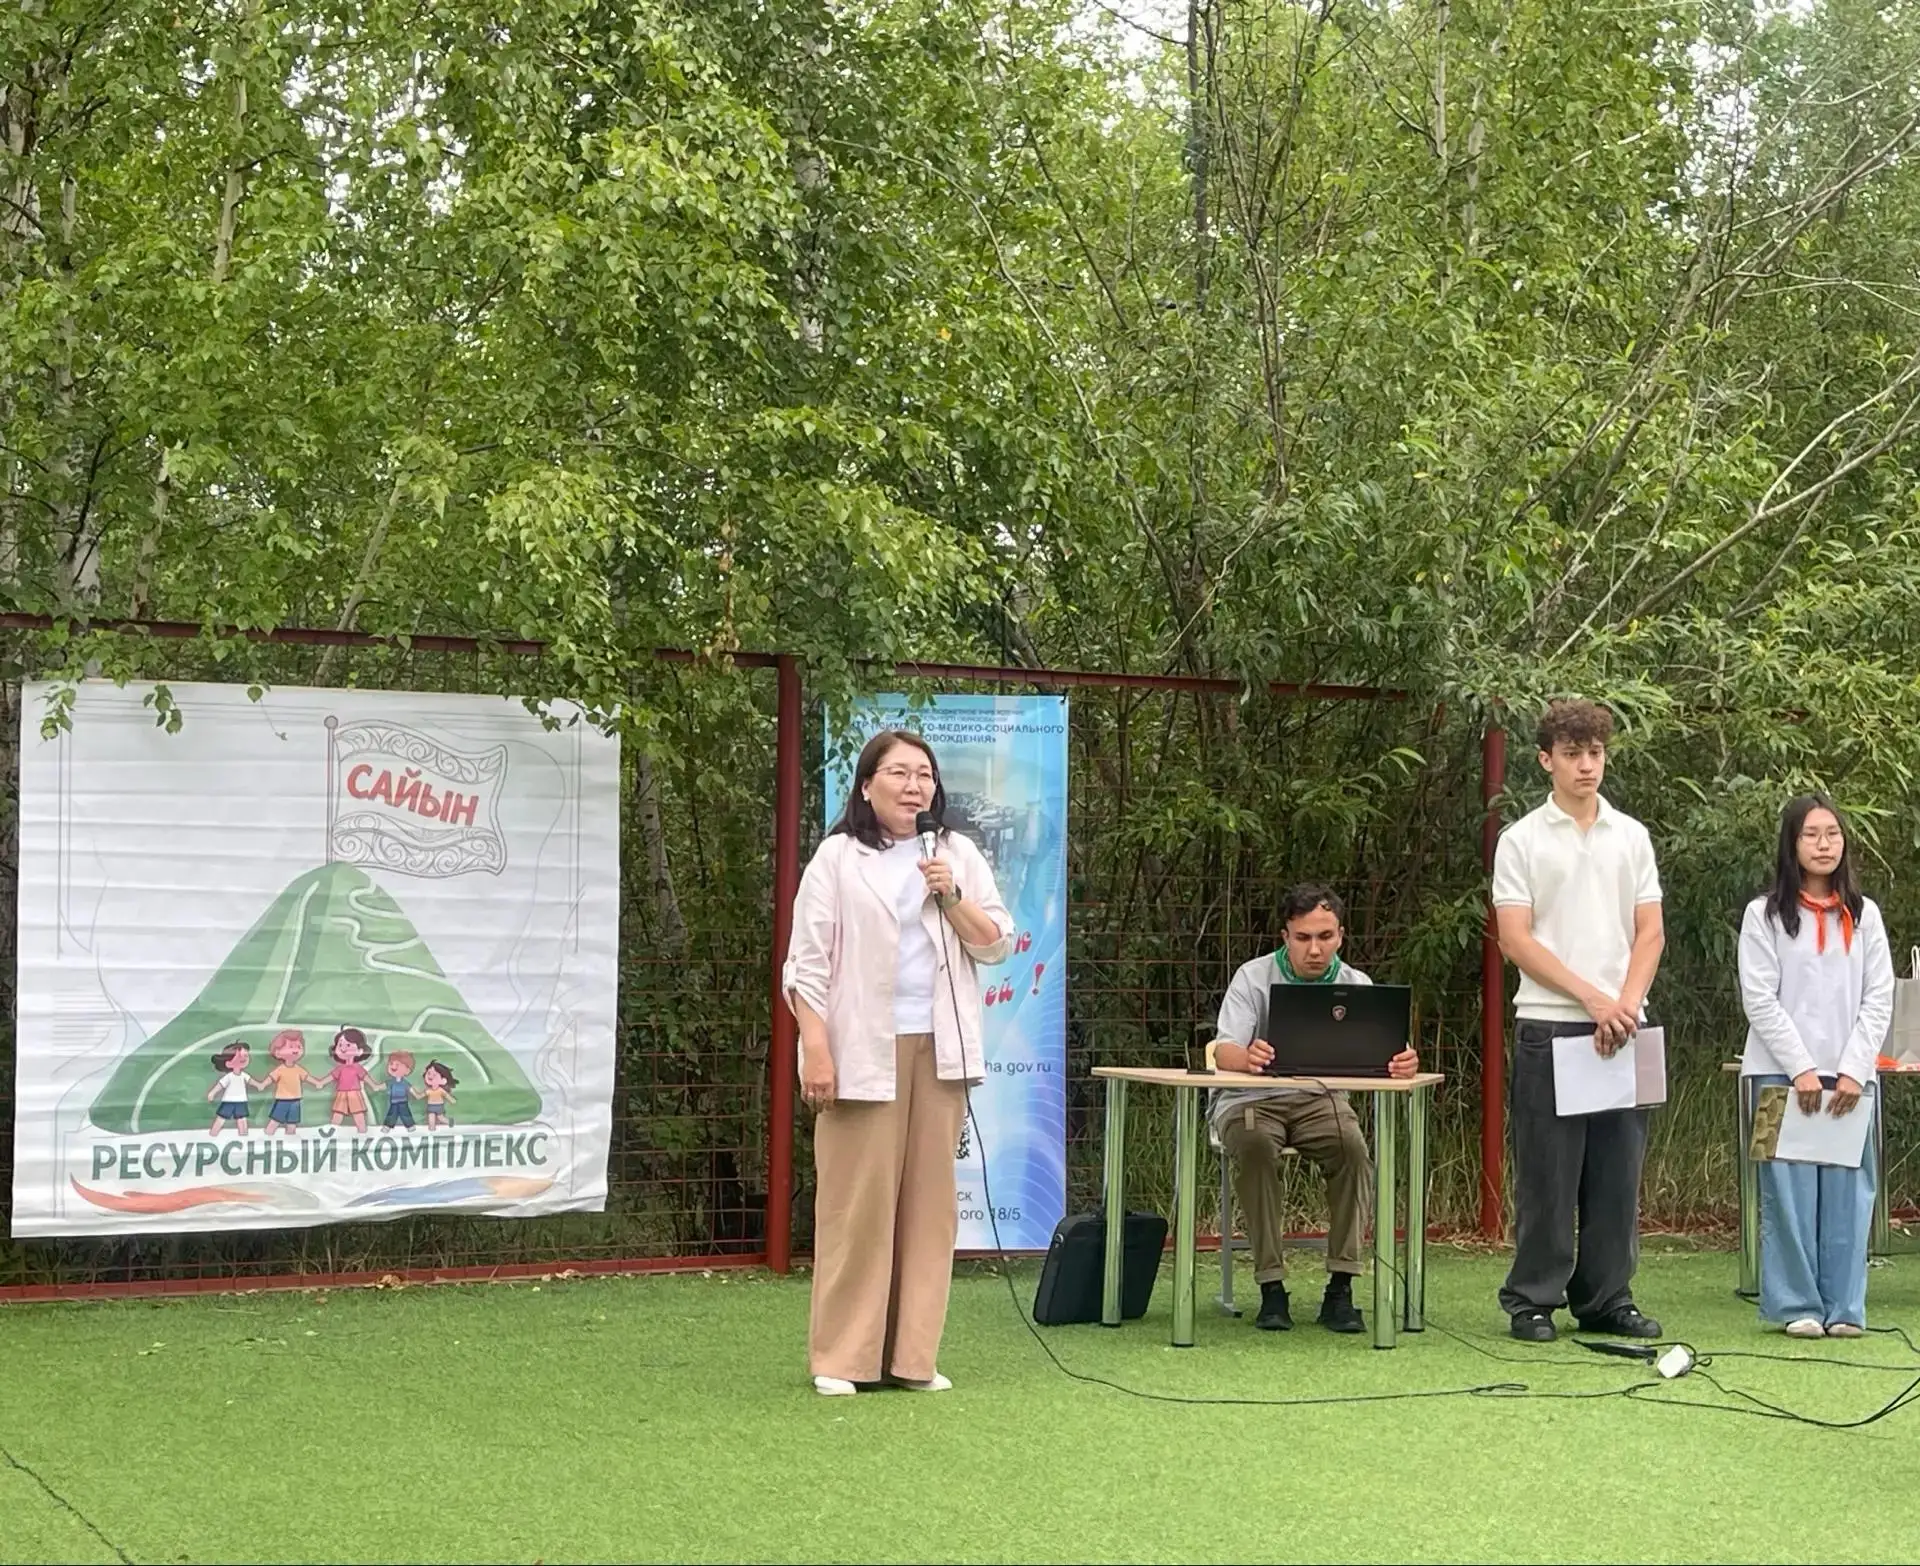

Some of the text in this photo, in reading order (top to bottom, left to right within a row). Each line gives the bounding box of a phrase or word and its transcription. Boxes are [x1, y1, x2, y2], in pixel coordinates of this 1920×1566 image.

[347, 764, 479, 826] САЙЫН
[91, 1128, 548, 1181] РЕСУРСНЫЙ КОМПЛЕКС
